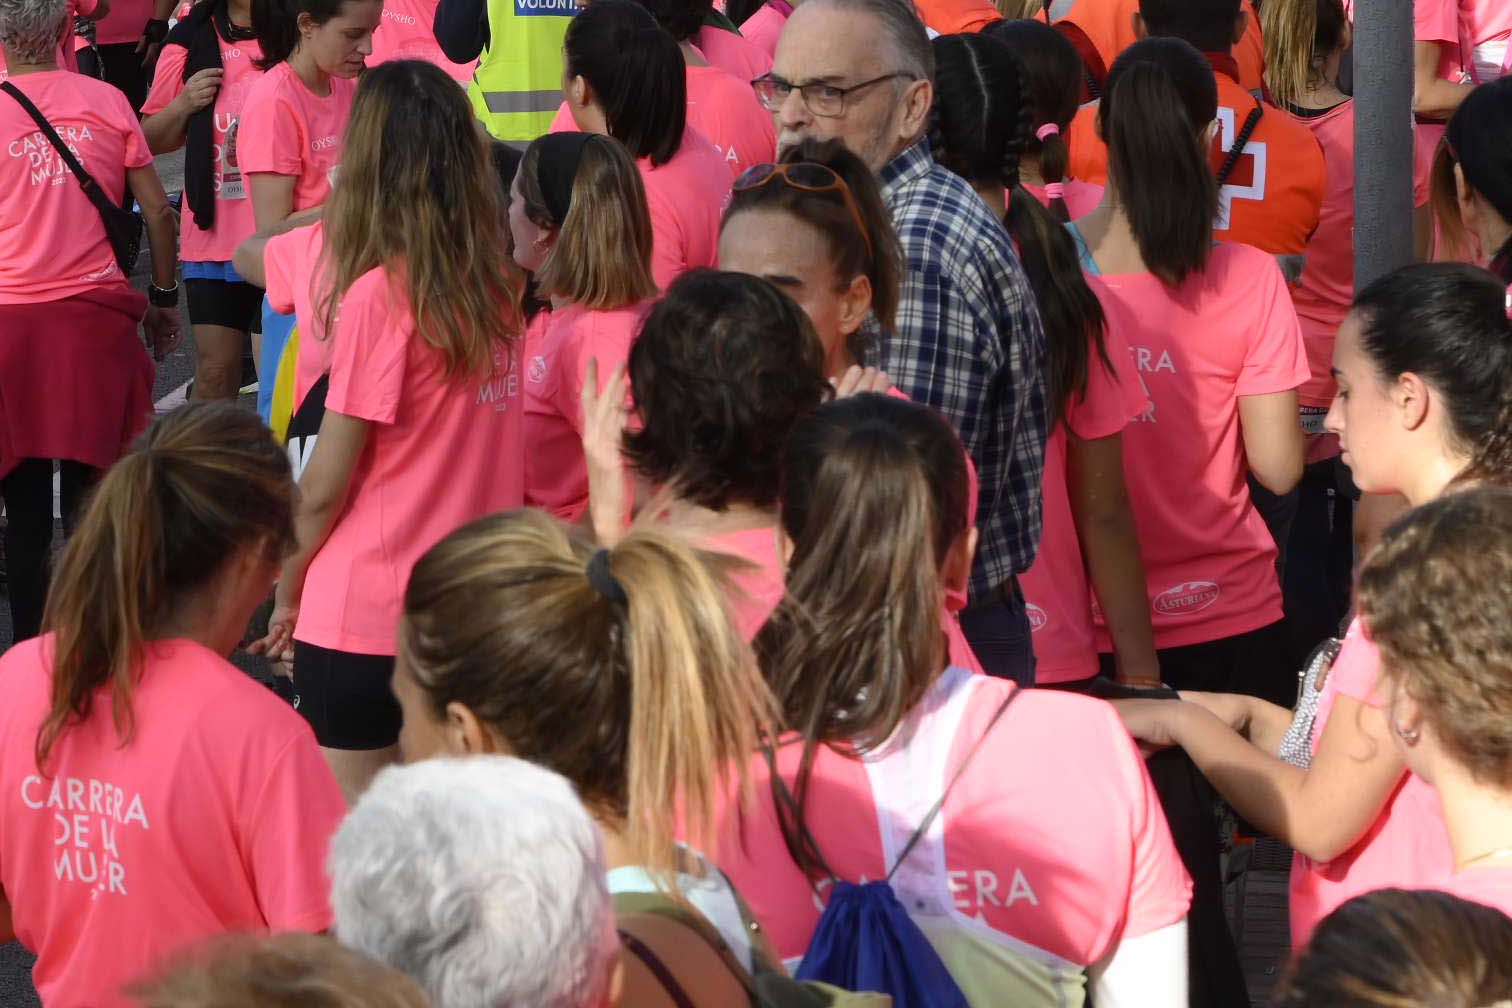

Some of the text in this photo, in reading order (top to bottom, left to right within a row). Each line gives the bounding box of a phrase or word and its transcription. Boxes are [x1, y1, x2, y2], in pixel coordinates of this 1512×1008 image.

[381, 8, 416, 26] OYSHO
[7, 125, 94, 159] CARERA
[20, 774, 151, 830] CARRERA
[53, 813, 90, 849] DE
